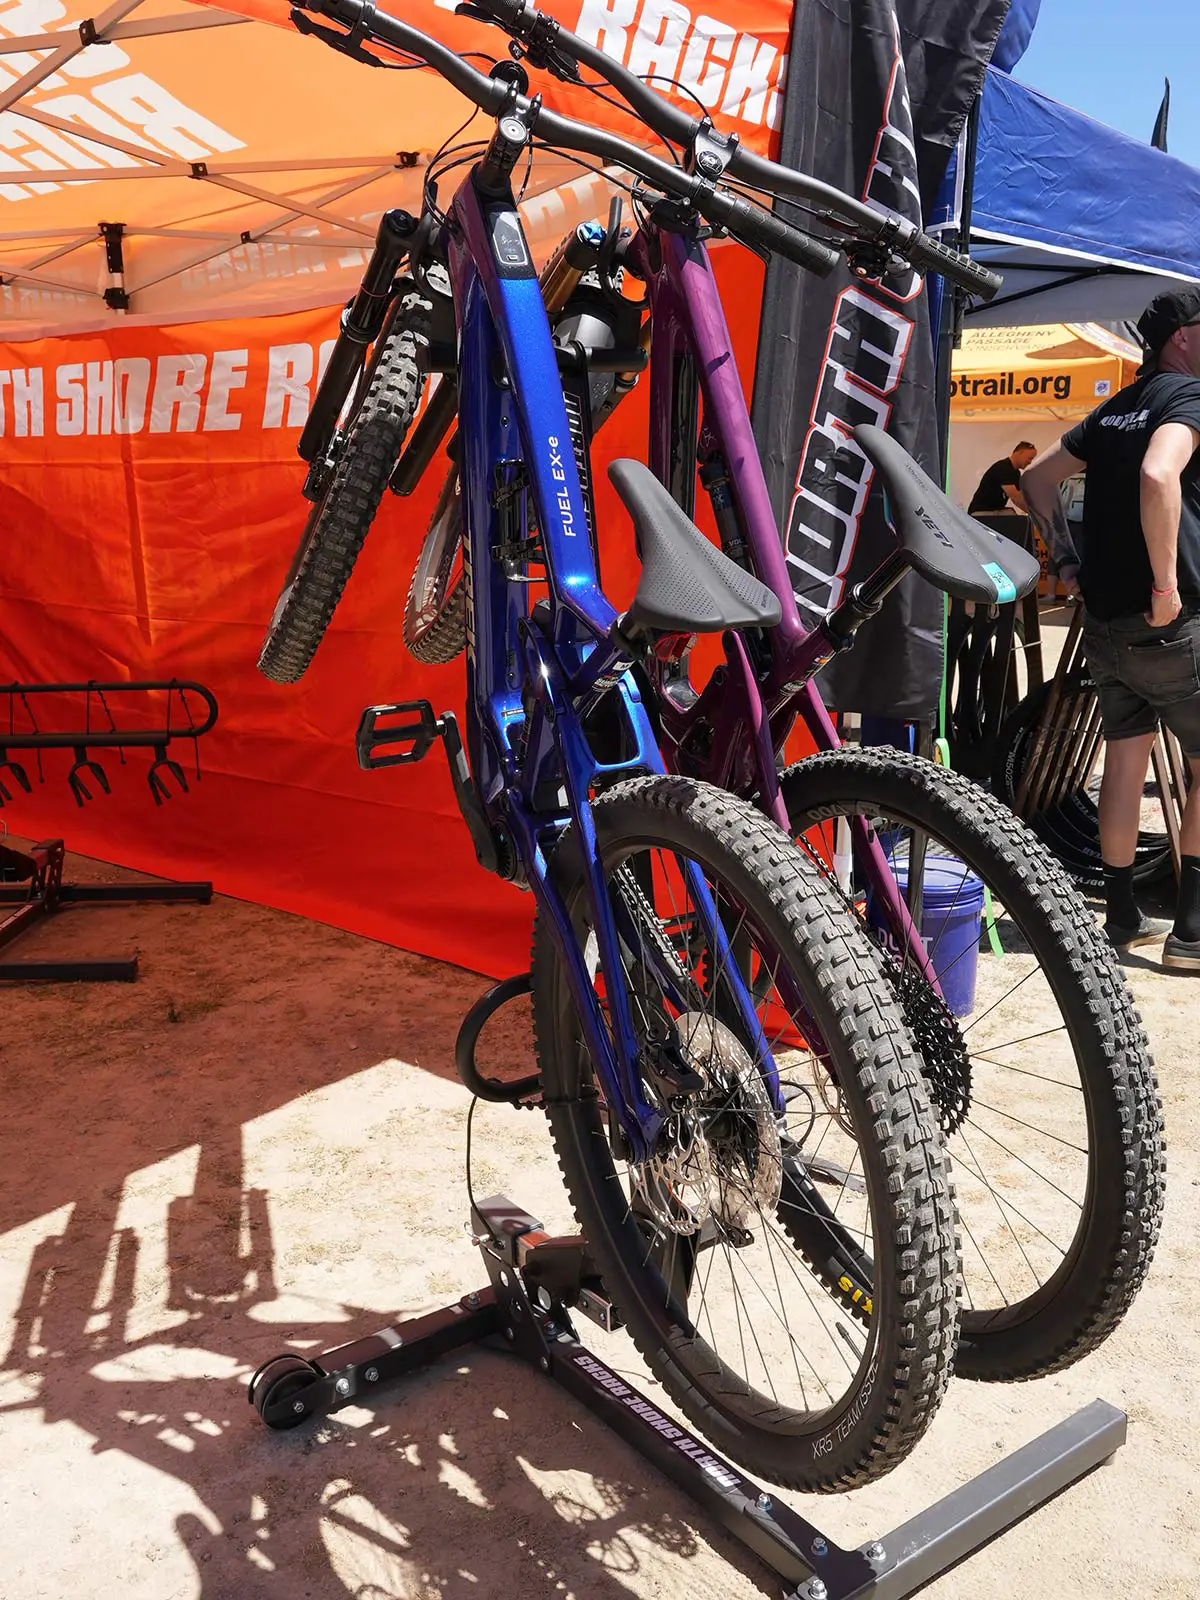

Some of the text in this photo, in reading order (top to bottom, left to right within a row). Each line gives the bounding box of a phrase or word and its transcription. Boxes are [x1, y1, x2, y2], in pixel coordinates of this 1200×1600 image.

[970, 330, 1056, 338] ALLEGHENY
[56, 349, 249, 436] SHORE
[549, 435, 577, 537] FUEL EX-e
[914, 505, 954, 549] YETI
[573, 1355, 742, 1488] NORTH SHORE RACKS
[812, 1433, 833, 1460] XR5
[835, 1399, 861, 1442] TEAM
